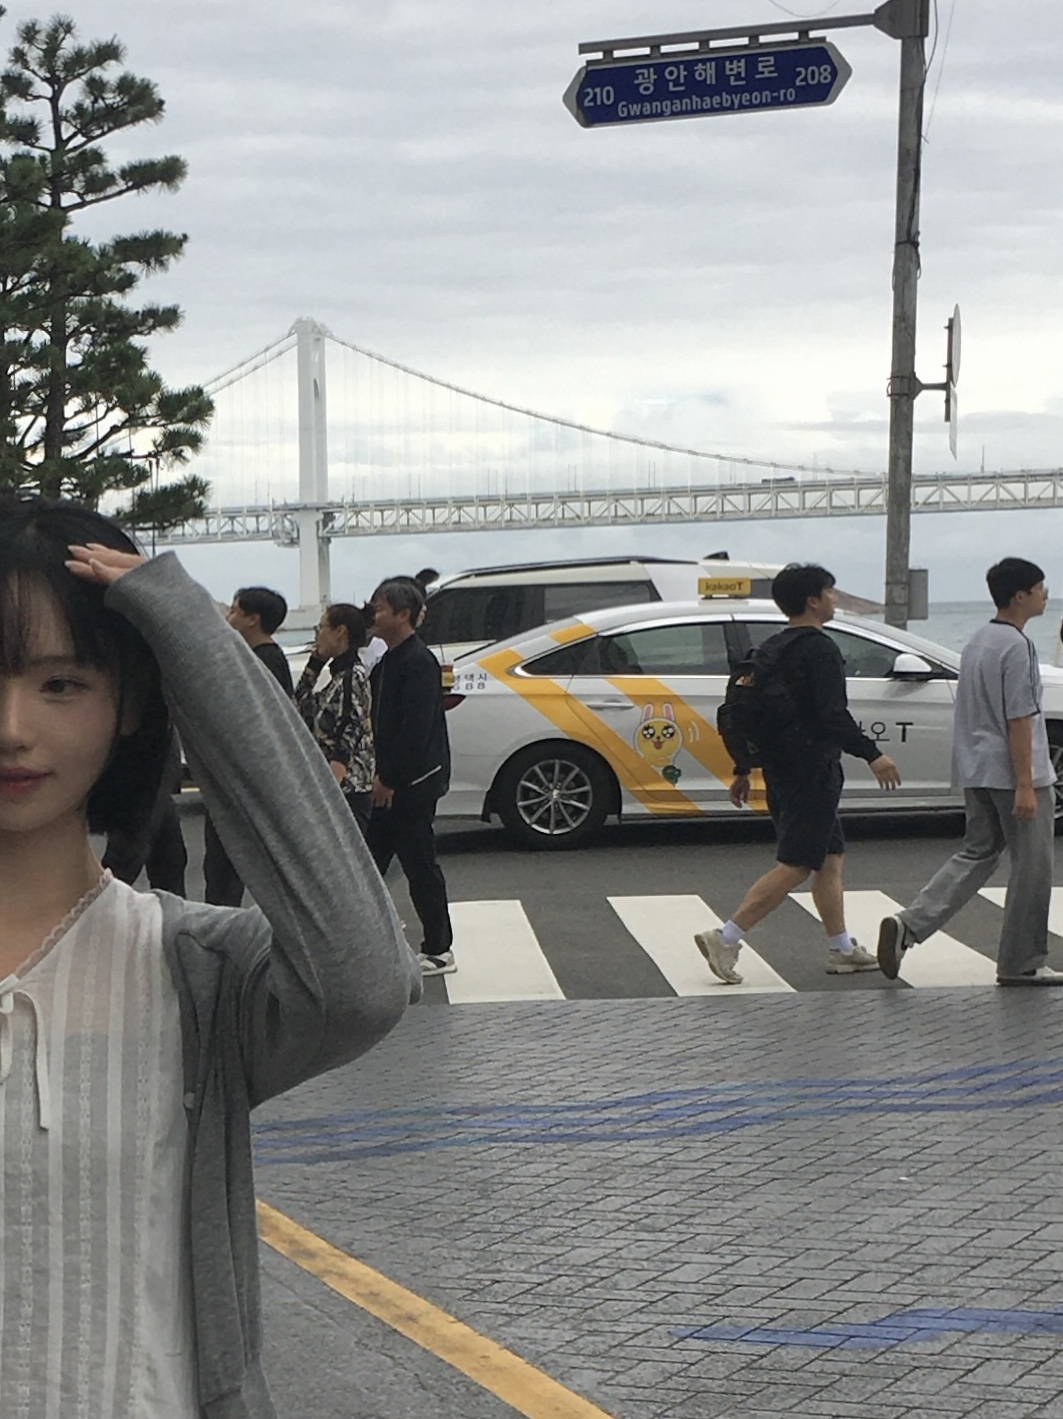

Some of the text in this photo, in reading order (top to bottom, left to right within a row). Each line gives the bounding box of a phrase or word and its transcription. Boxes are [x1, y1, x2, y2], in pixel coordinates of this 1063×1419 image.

[634, 56, 778, 95] 광안해변로
[795, 64, 832, 86] 208
[583, 86, 615, 107] 210
[617, 88, 796, 117] Gwanganhaebyeon-ro
[856, 720, 891, 742] 오
